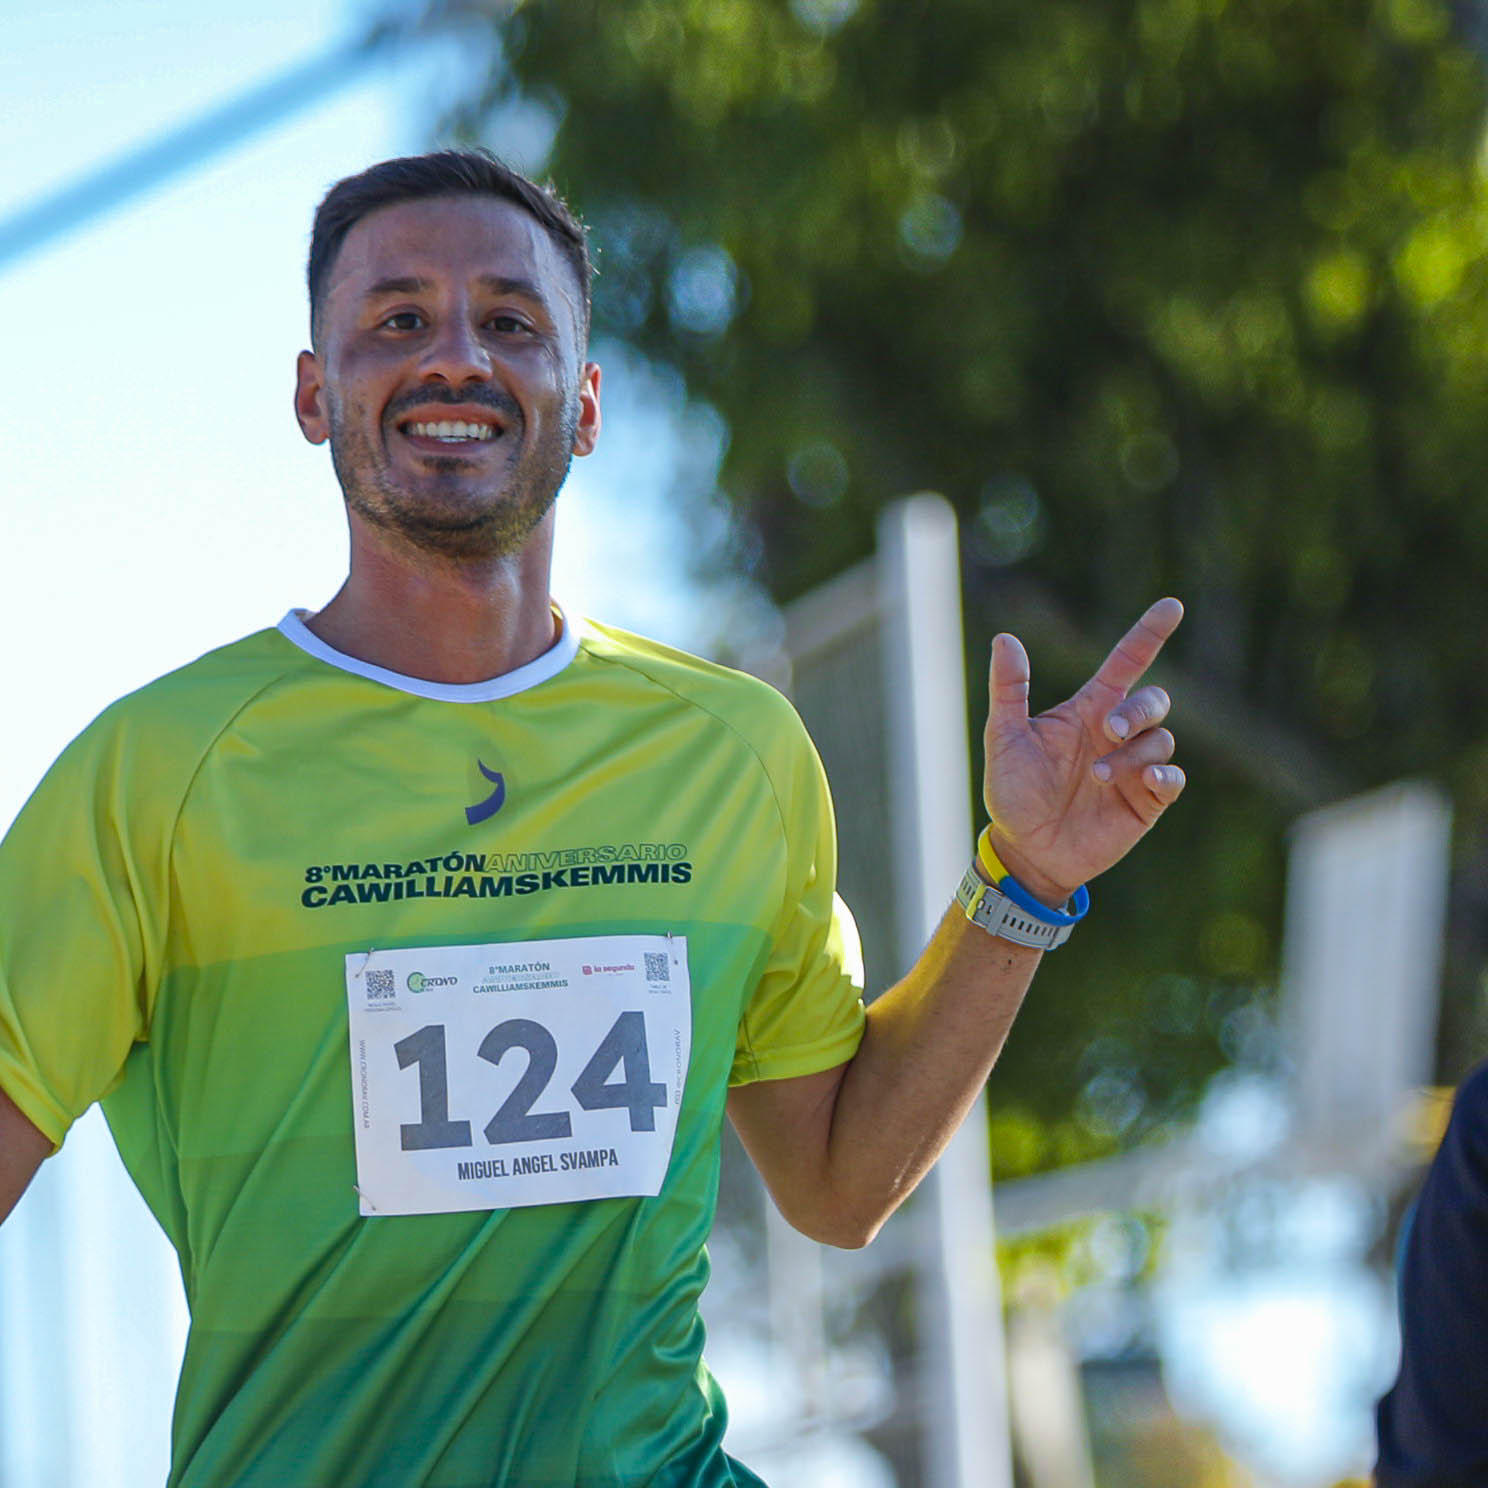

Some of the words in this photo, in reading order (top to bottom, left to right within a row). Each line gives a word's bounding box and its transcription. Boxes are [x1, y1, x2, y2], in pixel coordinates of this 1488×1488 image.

[300, 861, 692, 909] CAWILLIAMSKEMMIS
[393, 1010, 668, 1151] 124
[457, 1159, 510, 1181] MIGUEL
[512, 1154, 558, 1176] ANGEL
[559, 1148, 619, 1171] SVAMPA
